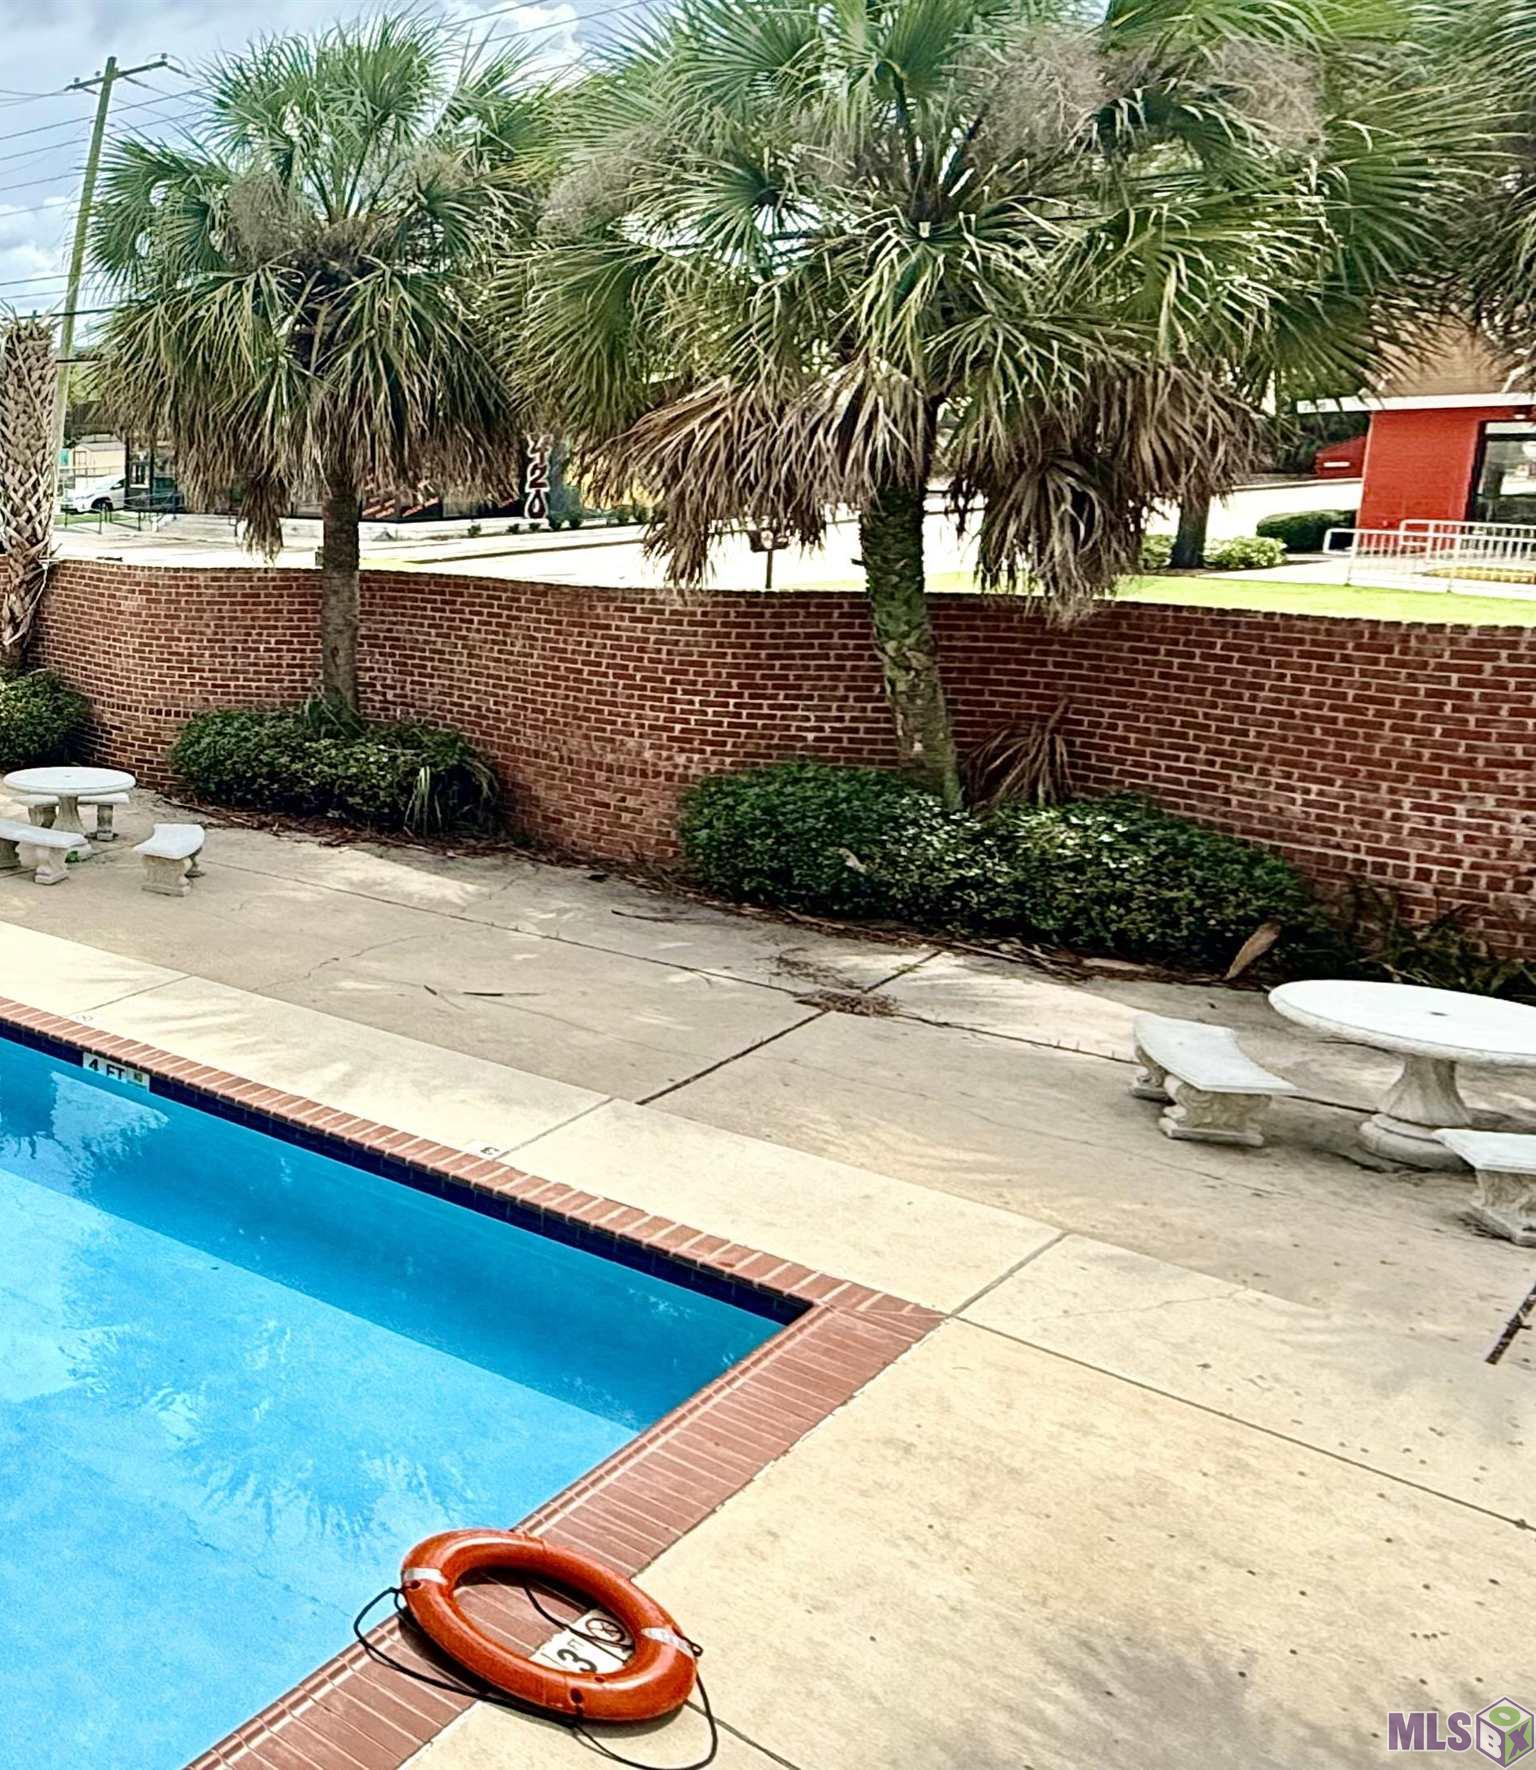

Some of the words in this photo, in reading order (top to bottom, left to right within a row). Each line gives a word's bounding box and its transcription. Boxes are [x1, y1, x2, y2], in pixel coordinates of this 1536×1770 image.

[88, 1058, 100, 1072] 4
[106, 1064, 125, 1080] FT
[556, 1648, 598, 1674] 3
